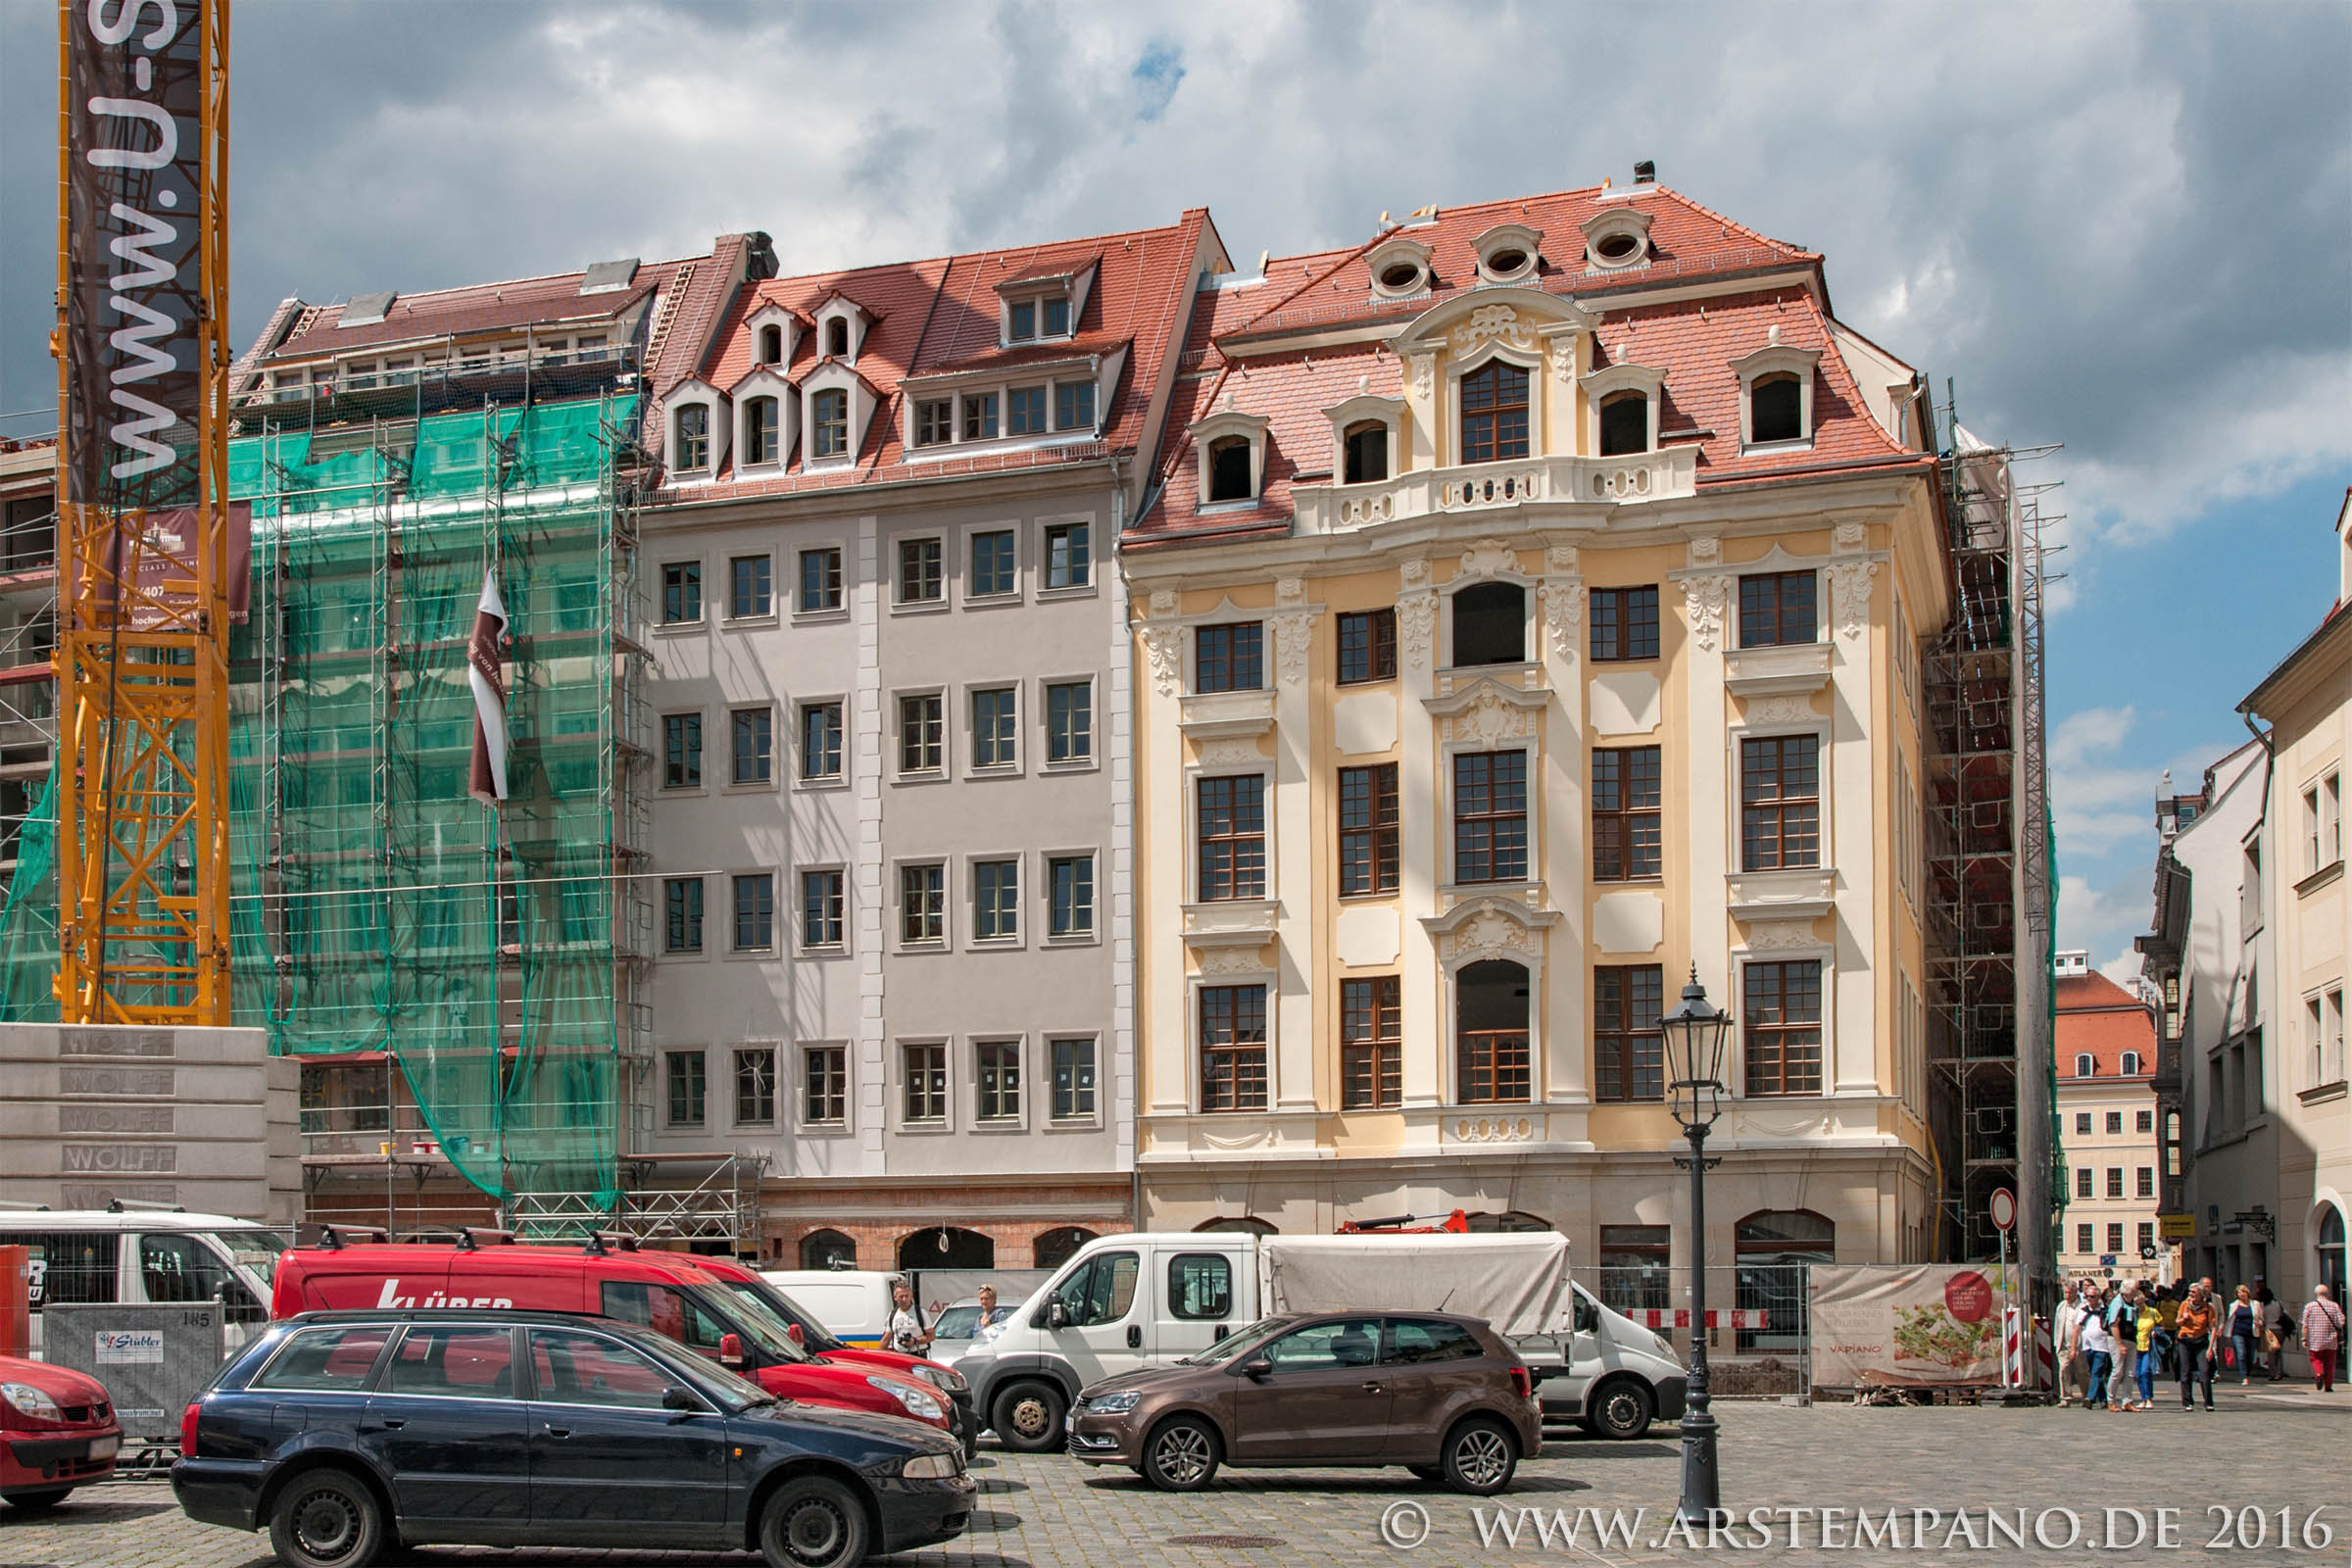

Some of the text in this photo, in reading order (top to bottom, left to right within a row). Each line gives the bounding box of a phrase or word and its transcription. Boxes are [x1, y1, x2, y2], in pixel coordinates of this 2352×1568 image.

[139, 564, 166, 572] CLASS
[478, 654, 493, 671] von
[69, 1033, 173, 1054] WOLFF
[69, 1070, 173, 1093] WOLFF
[67, 1107, 172, 1131] WOLFF
[66, 1147, 173, 1170] WOLFF
[2068, 1269, 2102, 1278] AULANER
[116, 1334, 161, 1349] Stübler
[1829, 1343, 1883, 1355] VAPIANO
